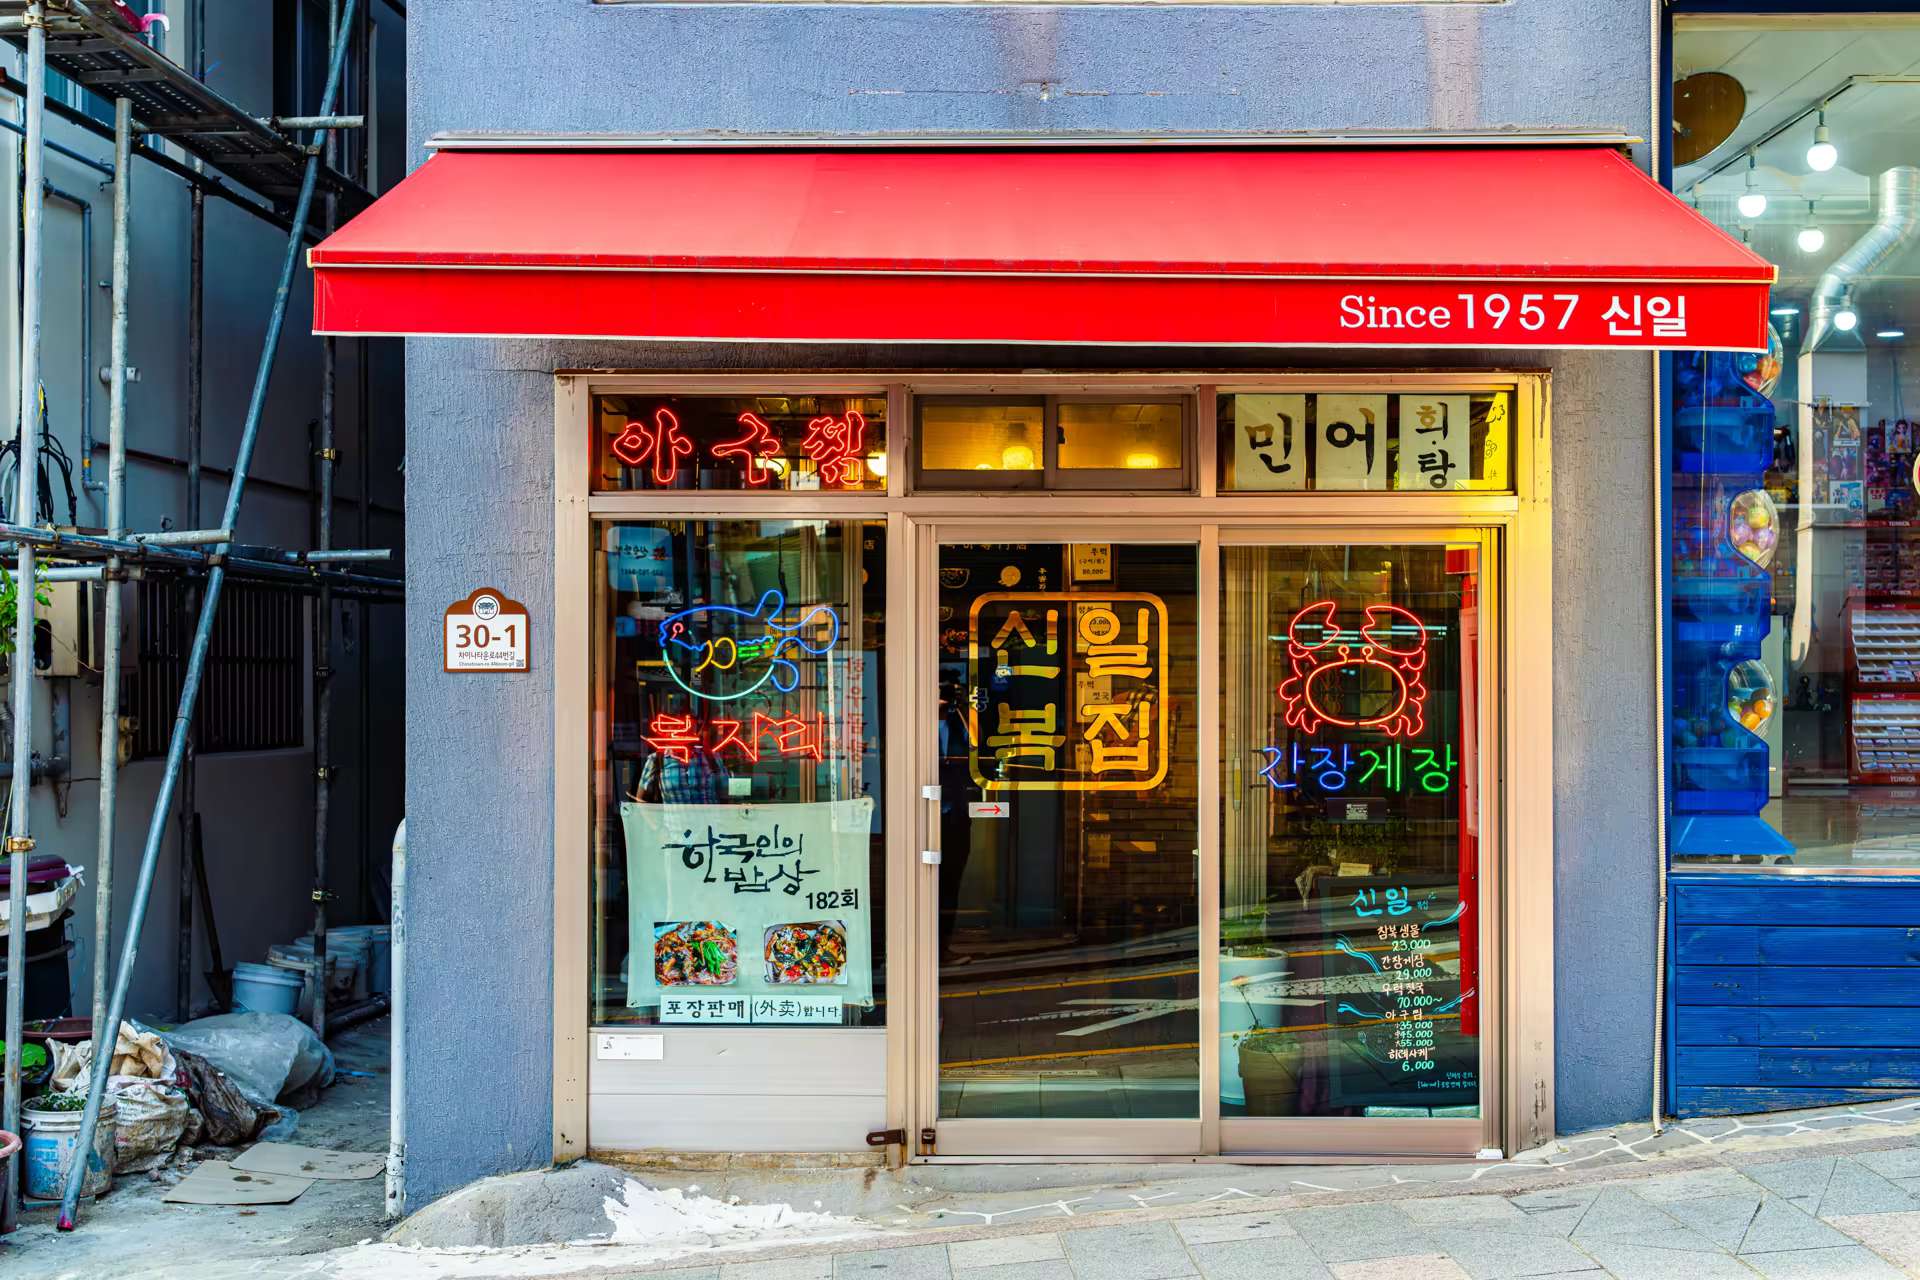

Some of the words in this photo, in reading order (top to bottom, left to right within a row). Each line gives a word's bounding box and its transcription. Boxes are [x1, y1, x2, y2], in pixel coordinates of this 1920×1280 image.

[1339, 294, 1451, 329] Since
[1457, 293, 1579, 331] 1957
[1600, 294, 1688, 337] 신일
[612, 407, 866, 485] 아구찜
[455, 624, 516, 648] 30-1
[990, 607, 1153, 679] 신일
[458, 650, 515, 661] 차이나타운로44번길
[986, 701, 1150, 775] 복집
[1259, 742, 1458, 792] 간장게장
[661, 824, 803, 883] 한국인의
[723, 859, 820, 895] 밥상
[805, 888, 859, 910] 182회
[1349, 886, 1413, 917] 신일
[1381, 953, 1425, 970] 간장게장
[665, 999, 745, 1019] 포장판매
